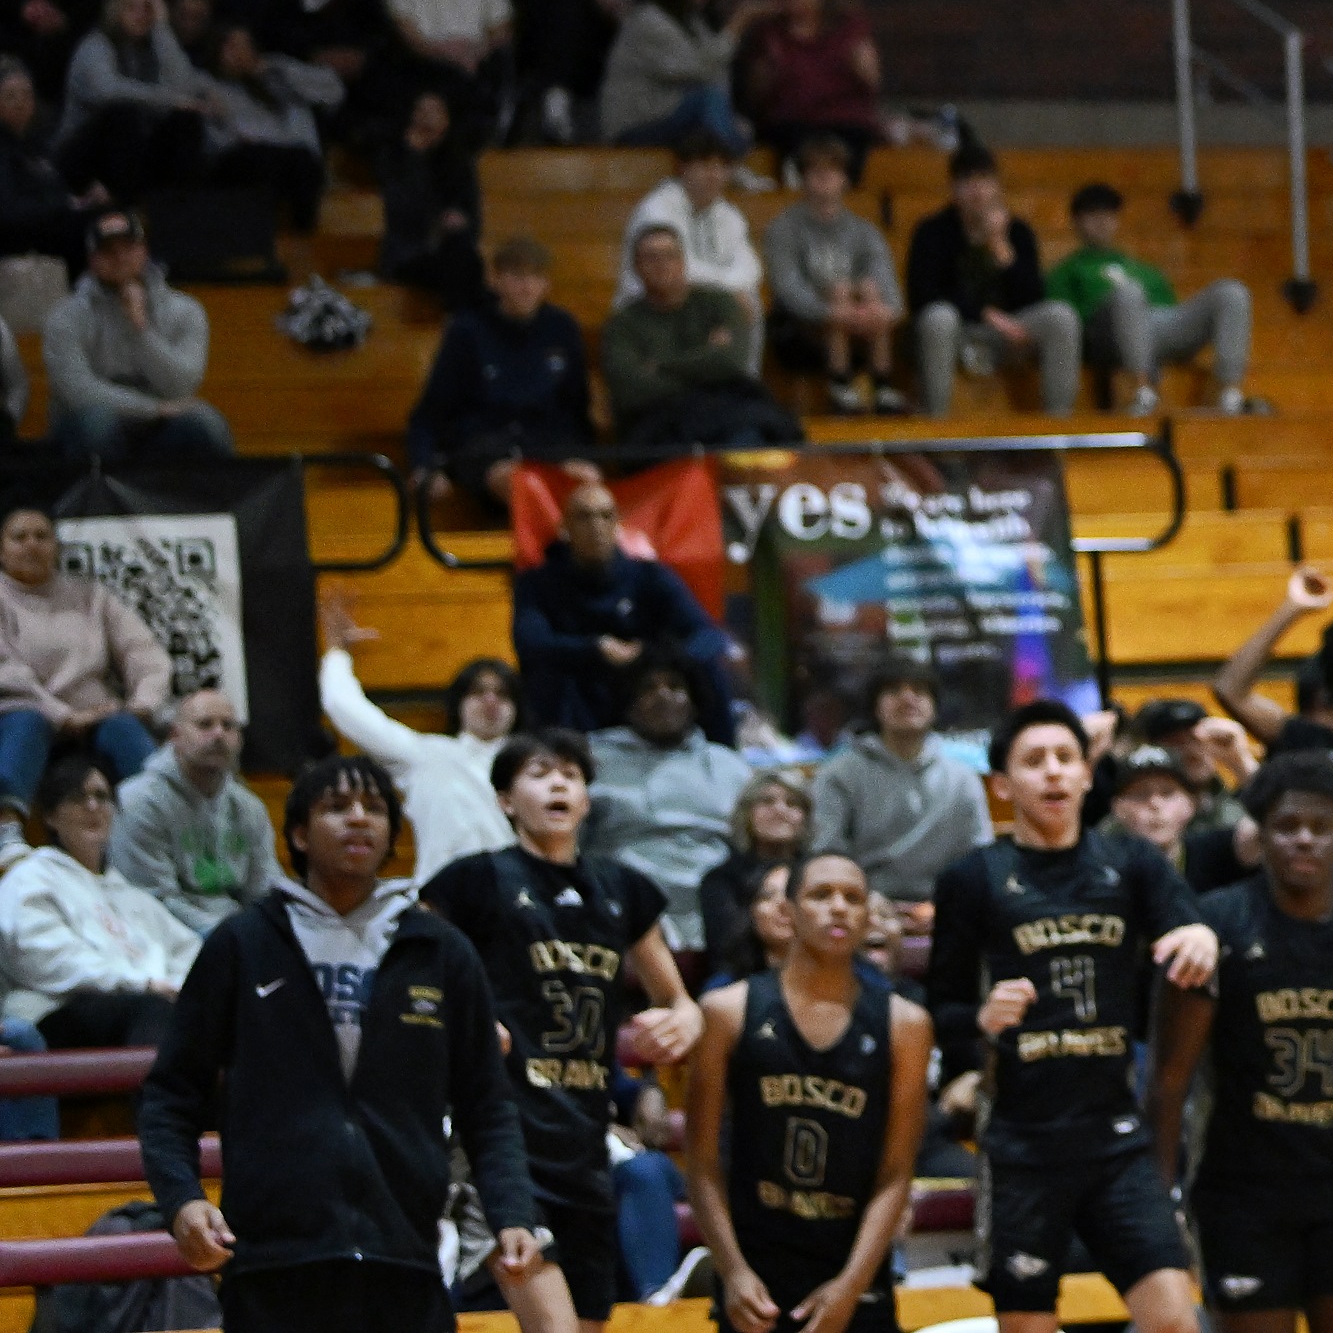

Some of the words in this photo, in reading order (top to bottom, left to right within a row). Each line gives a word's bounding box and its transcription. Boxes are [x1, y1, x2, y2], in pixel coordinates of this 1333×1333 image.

[724, 481, 872, 564] yes
[1050, 955, 1097, 1022] 4
[760, 1074, 867, 1119] BOSCO
